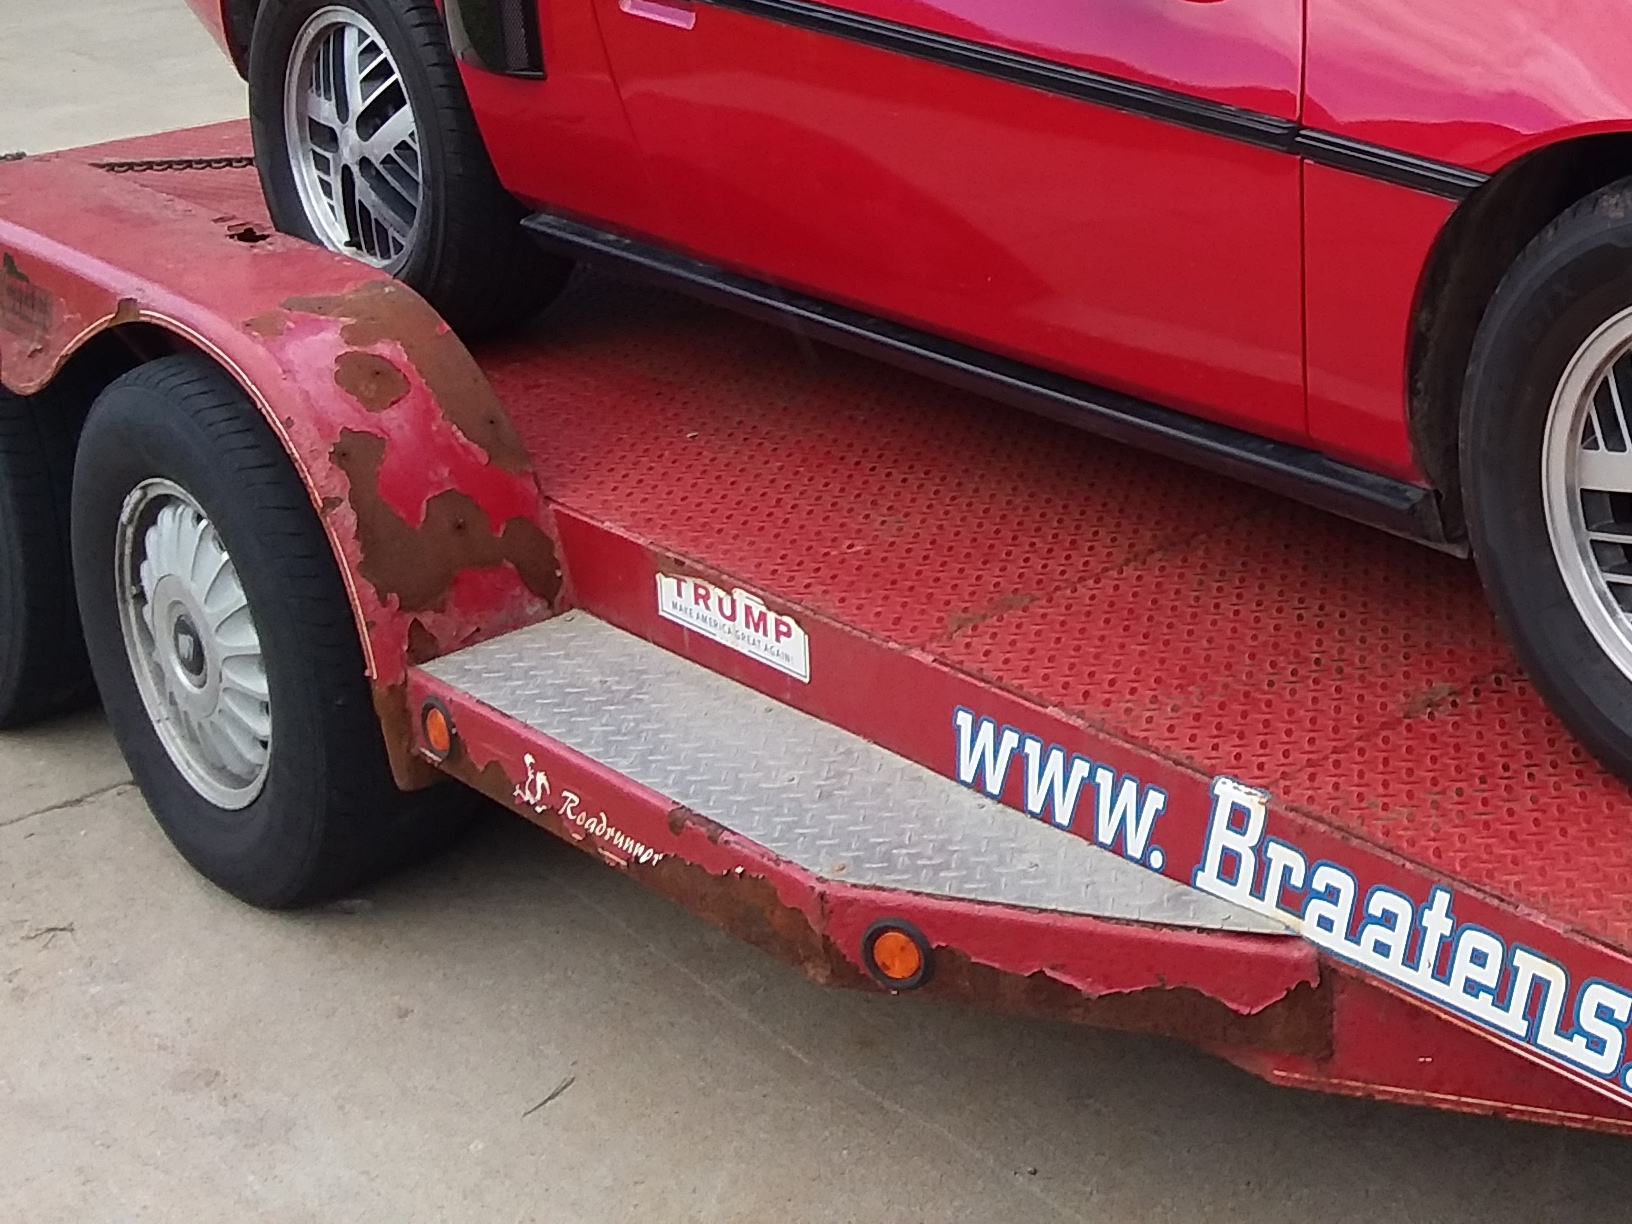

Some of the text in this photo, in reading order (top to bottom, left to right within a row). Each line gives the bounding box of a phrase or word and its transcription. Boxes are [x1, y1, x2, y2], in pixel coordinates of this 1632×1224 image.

[671, 600, 694, 619] MAKE
[695, 612, 732, 635] AMERICA
[735, 629, 762, 649] GREAT
[673, 578, 793, 643] TRUMP
[558, 790, 664, 867] Roadrunner
